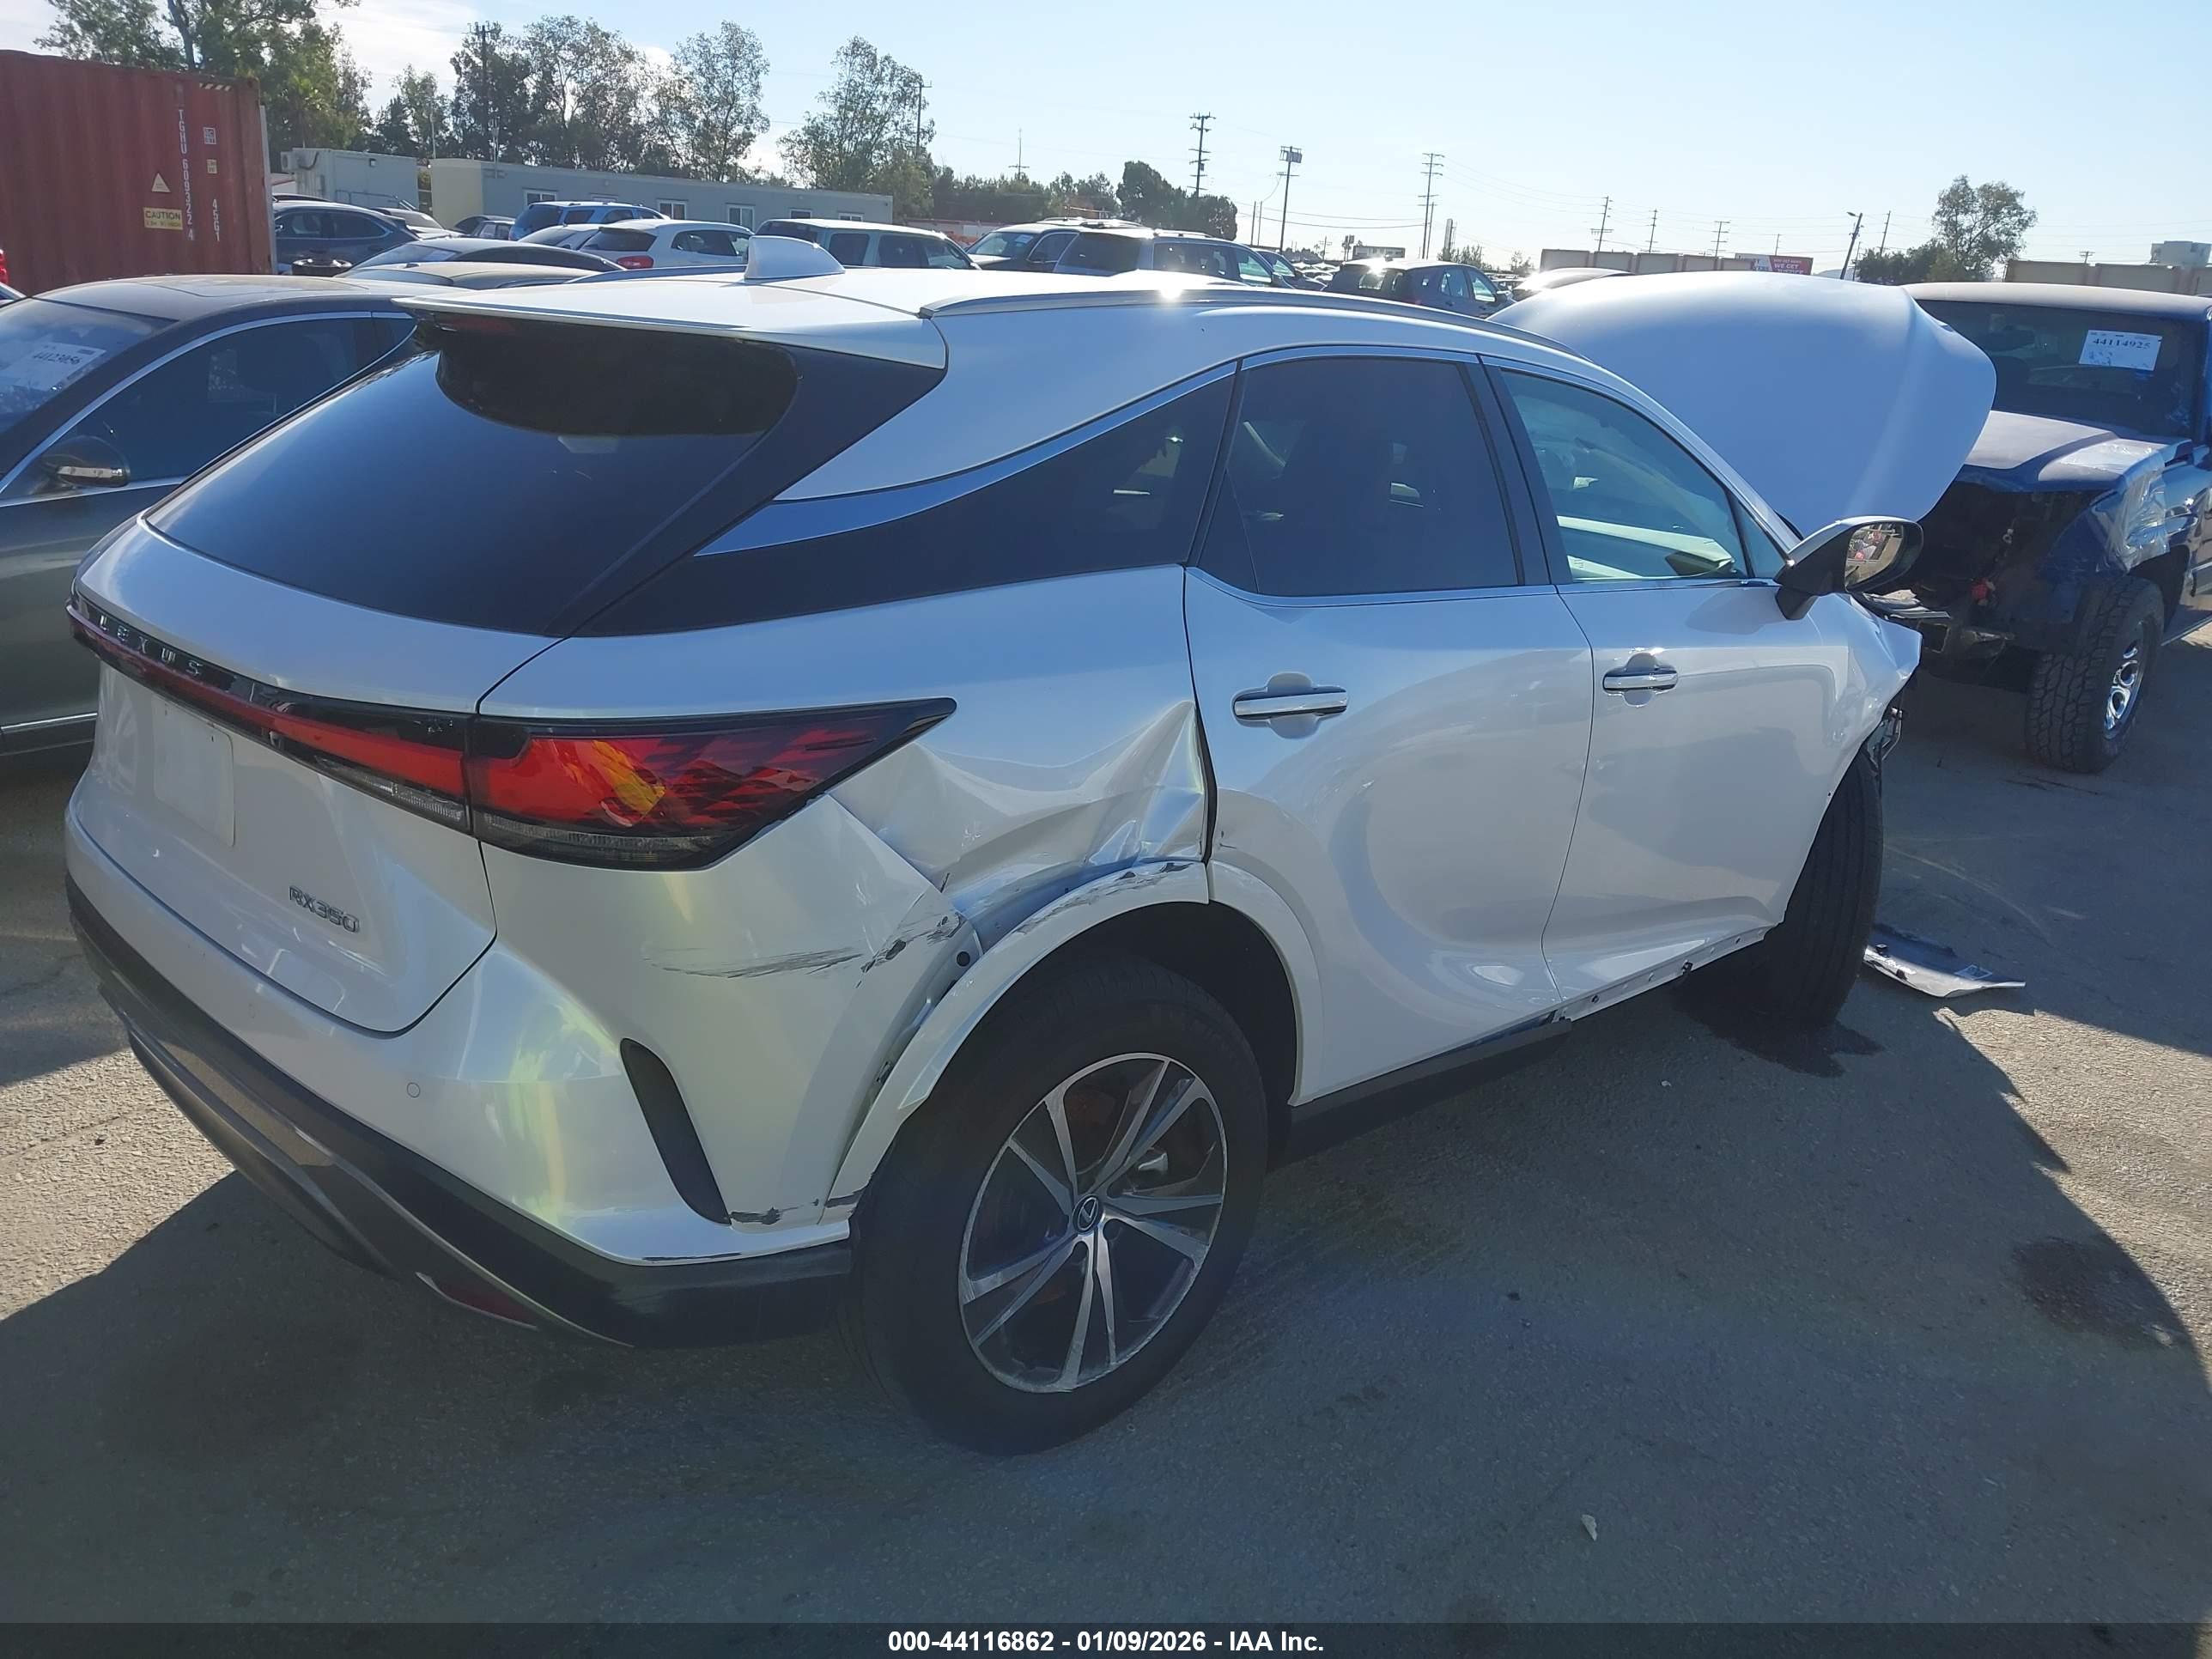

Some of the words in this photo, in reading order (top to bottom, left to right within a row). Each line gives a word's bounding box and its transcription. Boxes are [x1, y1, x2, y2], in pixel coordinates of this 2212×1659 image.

[179, 109, 187, 155] TGHU
[145, 210, 180, 221] CAUTION
[2093, 338, 2151, 349] 44114925
[100, 615, 204, 676] LEXUS
[289, 885, 360, 933] RX350
